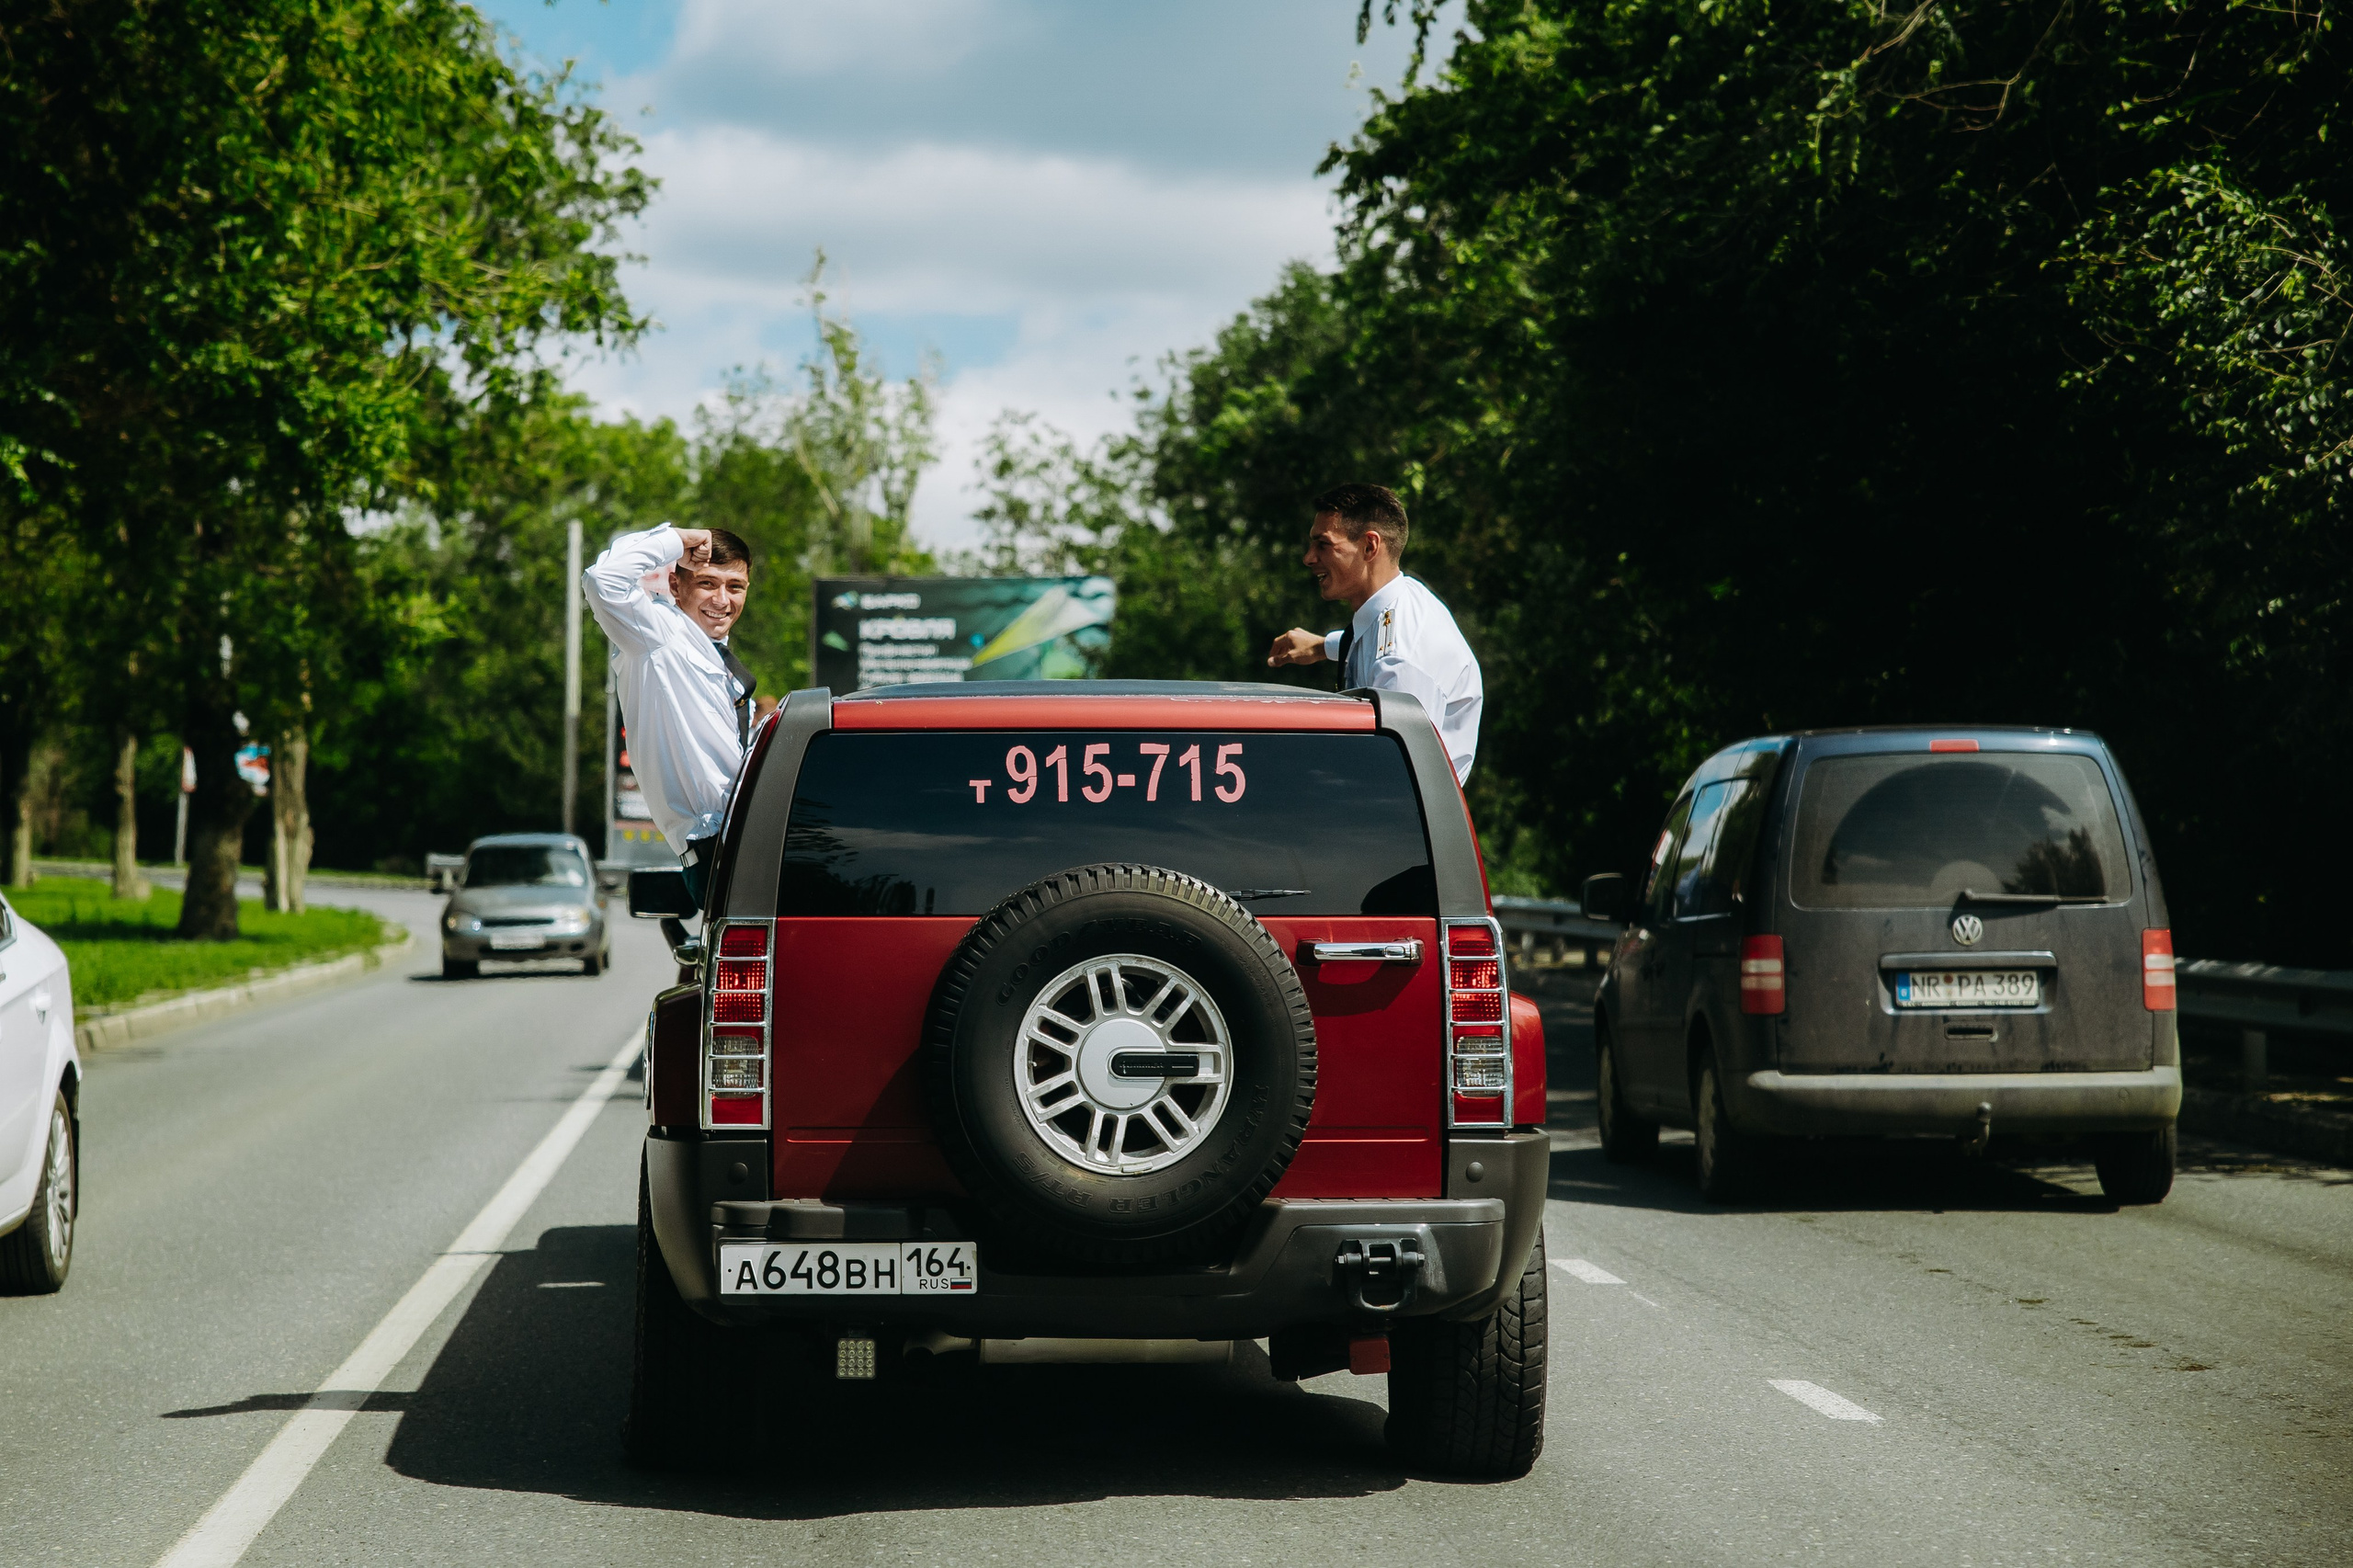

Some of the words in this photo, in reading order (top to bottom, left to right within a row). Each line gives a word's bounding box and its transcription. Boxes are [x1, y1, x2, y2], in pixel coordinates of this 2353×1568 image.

[1006, 743, 1246, 804] 915-715
[1911, 975, 1940, 997] NR
[1957, 974, 1986, 997] PA
[1994, 973, 2035, 996] 389
[1108, 1085, 1270, 1214] WRANGLER
[1013, 1151, 1094, 1209] RT/S
[906, 1247, 965, 1278] 164
[919, 1278, 949, 1290] RUS
